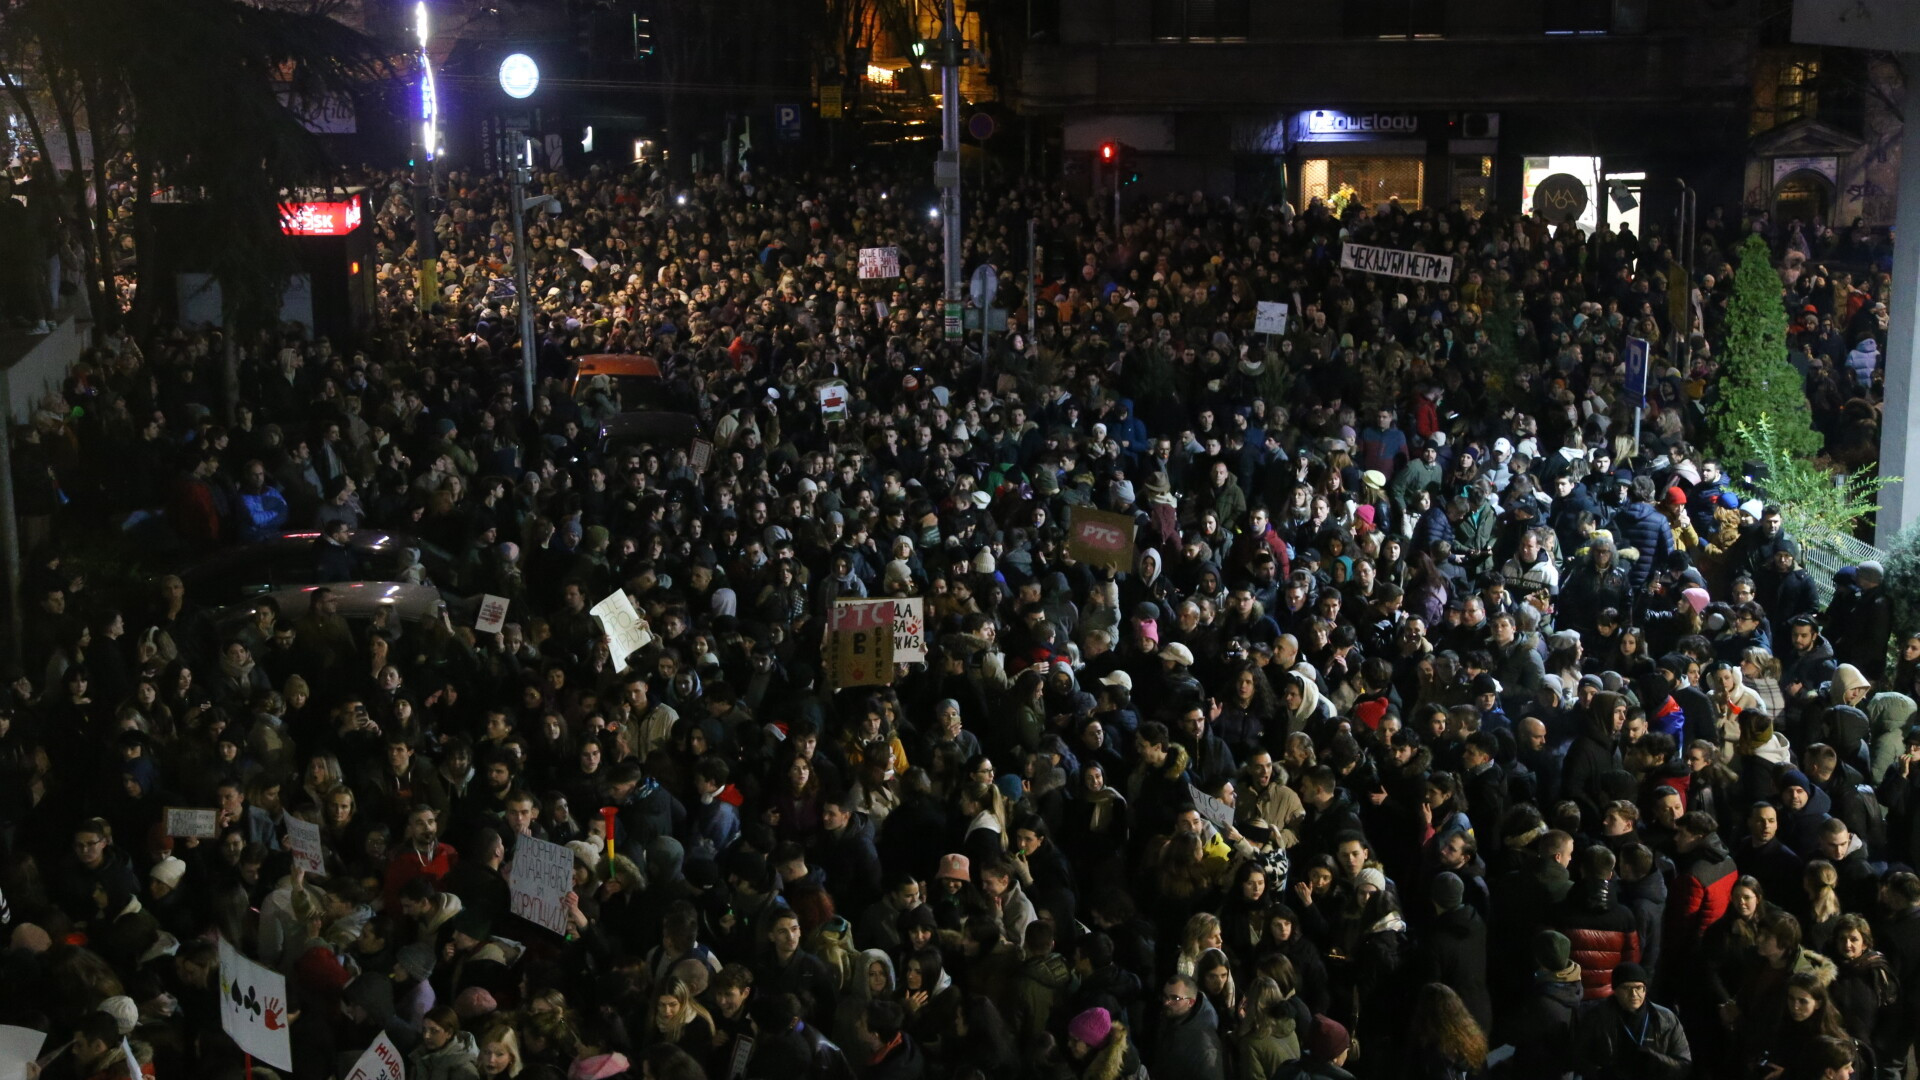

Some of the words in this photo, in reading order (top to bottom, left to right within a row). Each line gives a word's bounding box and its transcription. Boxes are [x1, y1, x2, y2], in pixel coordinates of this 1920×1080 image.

[781, 108, 794, 126] P
[1083, 525, 1120, 544] РТС
[832, 602, 885, 631] РТС
